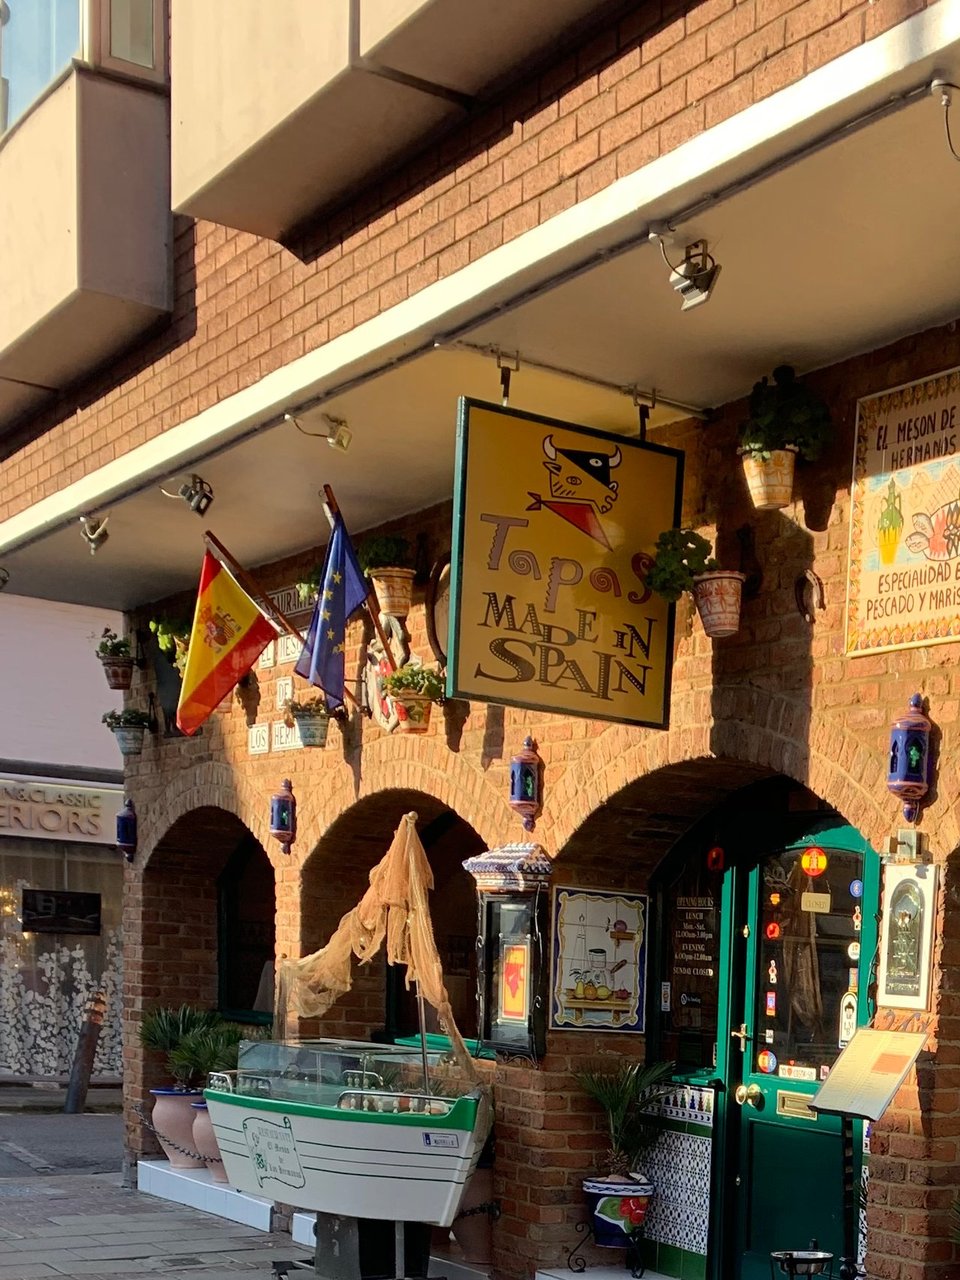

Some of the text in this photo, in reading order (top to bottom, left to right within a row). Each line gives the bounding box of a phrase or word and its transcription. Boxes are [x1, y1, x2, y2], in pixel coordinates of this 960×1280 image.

[876, 424, 889, 451] EL
[897, 411, 937, 444] MESON
[940, 405, 957, 431] DE
[891, 434, 957, 470] HERMANOS
[477, 592, 599, 647] MADE
[866, 593, 915, 620] PESCADO
[919, 591, 927, 612] Y
[474, 637, 653, 701] SPAIN
[251, 728, 267, 749] LOS
